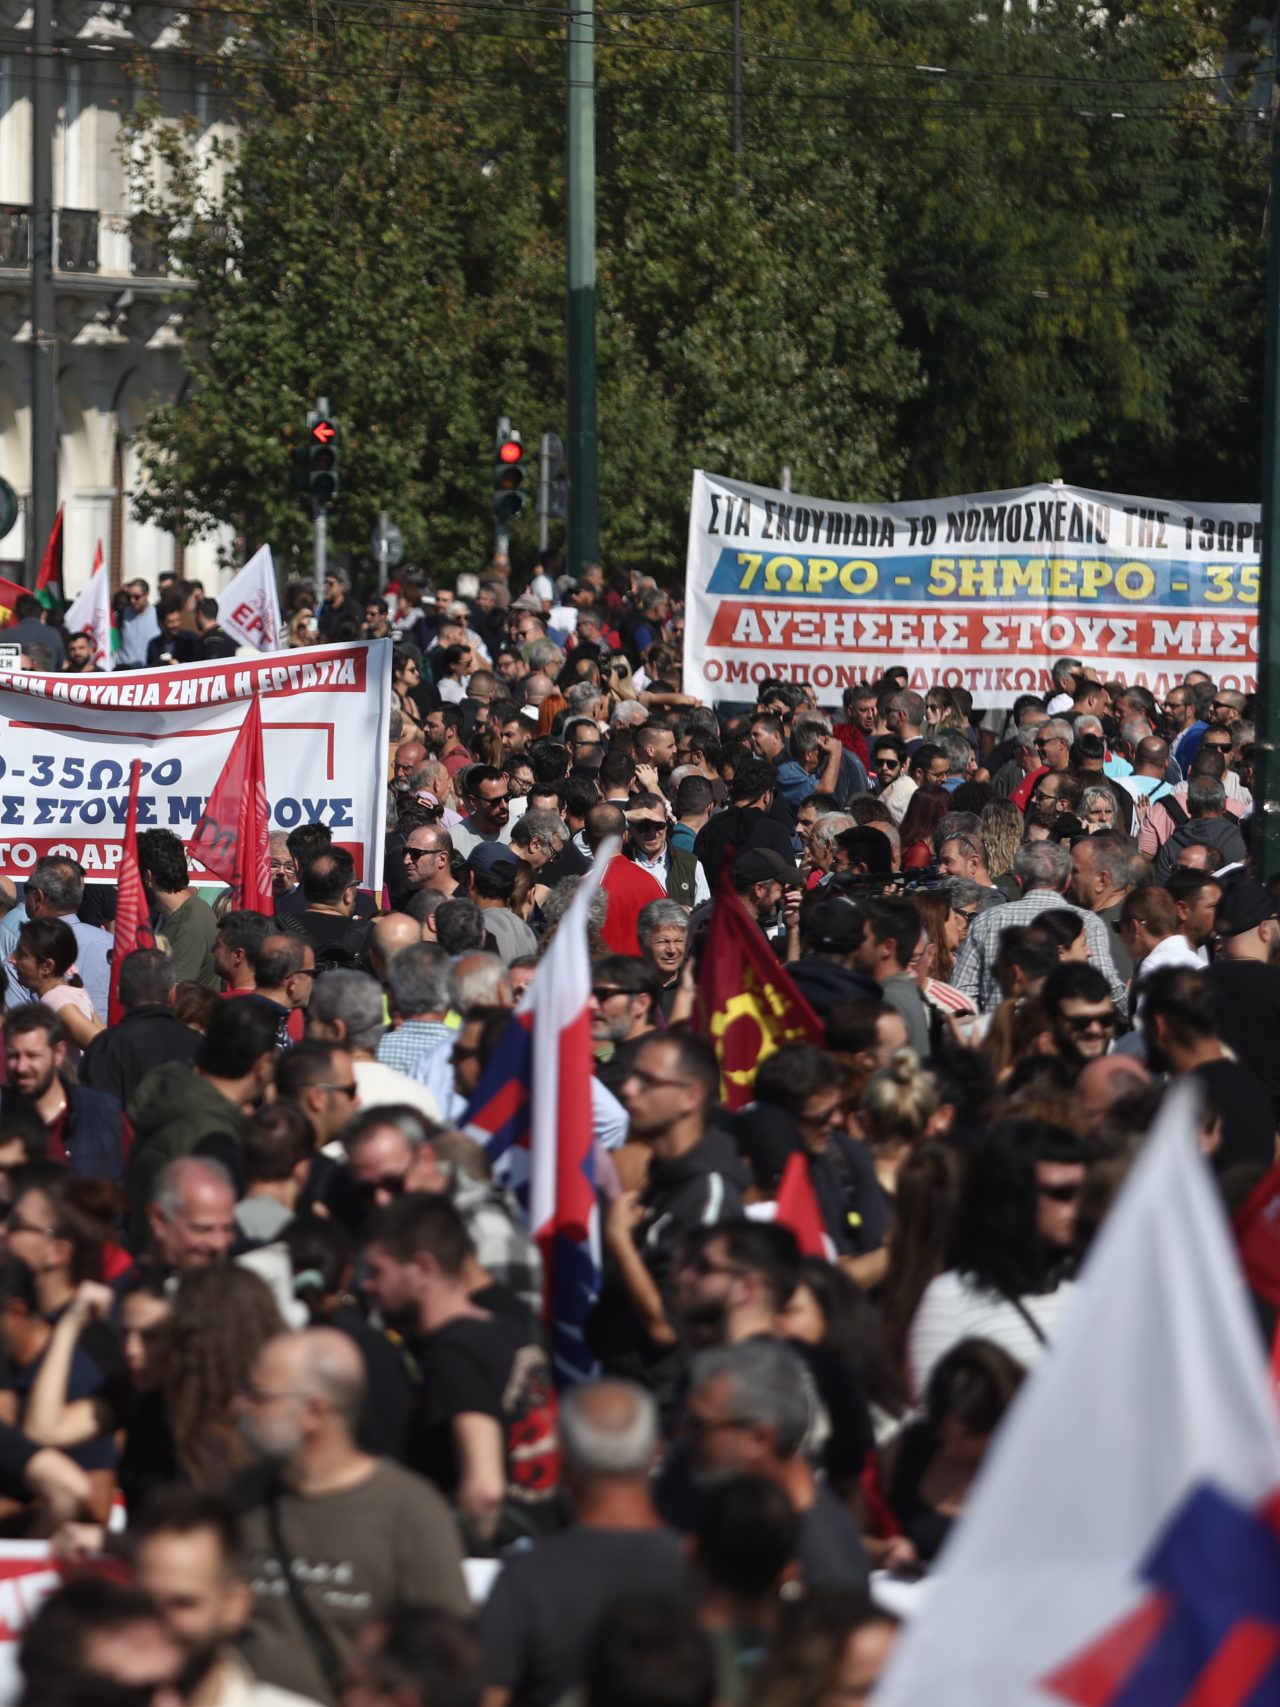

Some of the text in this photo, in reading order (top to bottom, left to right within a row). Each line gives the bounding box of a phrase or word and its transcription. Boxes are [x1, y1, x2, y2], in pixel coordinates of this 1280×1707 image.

[708, 494, 750, 537] ΣΤΑ
[761, 500, 895, 547] ΣΚΟΥΠΙΔΙΑ
[905, 515, 937, 546] ΤΟ
[945, 500, 1111, 545] ΝΟΜΟΣΧΕΔΙΟ
[1123, 506, 1170, 549] ΤΗΣ
[737, 553, 879, 594] 7ΩΡΟ
[927, 558, 1155, 600] 5ΗΜΕΡΟ
[1203, 565, 1261, 603] 35
[731, 608, 1258, 657] ΑΥΞΗΣΕΙΣ ΣΤΟΥΣ ΜΙΣ
[52, 680, 160, 707] ΔΟΥΛΕΙΑ
[165, 674, 229, 705] ΖΗΤΑ
[233, 670, 253, 698] Η
[258, 658, 357, 693] ΕΡΓΑΤΙΑ
[908, 666, 1056, 691] ΔΙΩΤΙΚΩΝ
[33, 796, 157, 825] ΣΤΟΥΣ
[168, 796, 354, 827] ΜΟΥΣ
